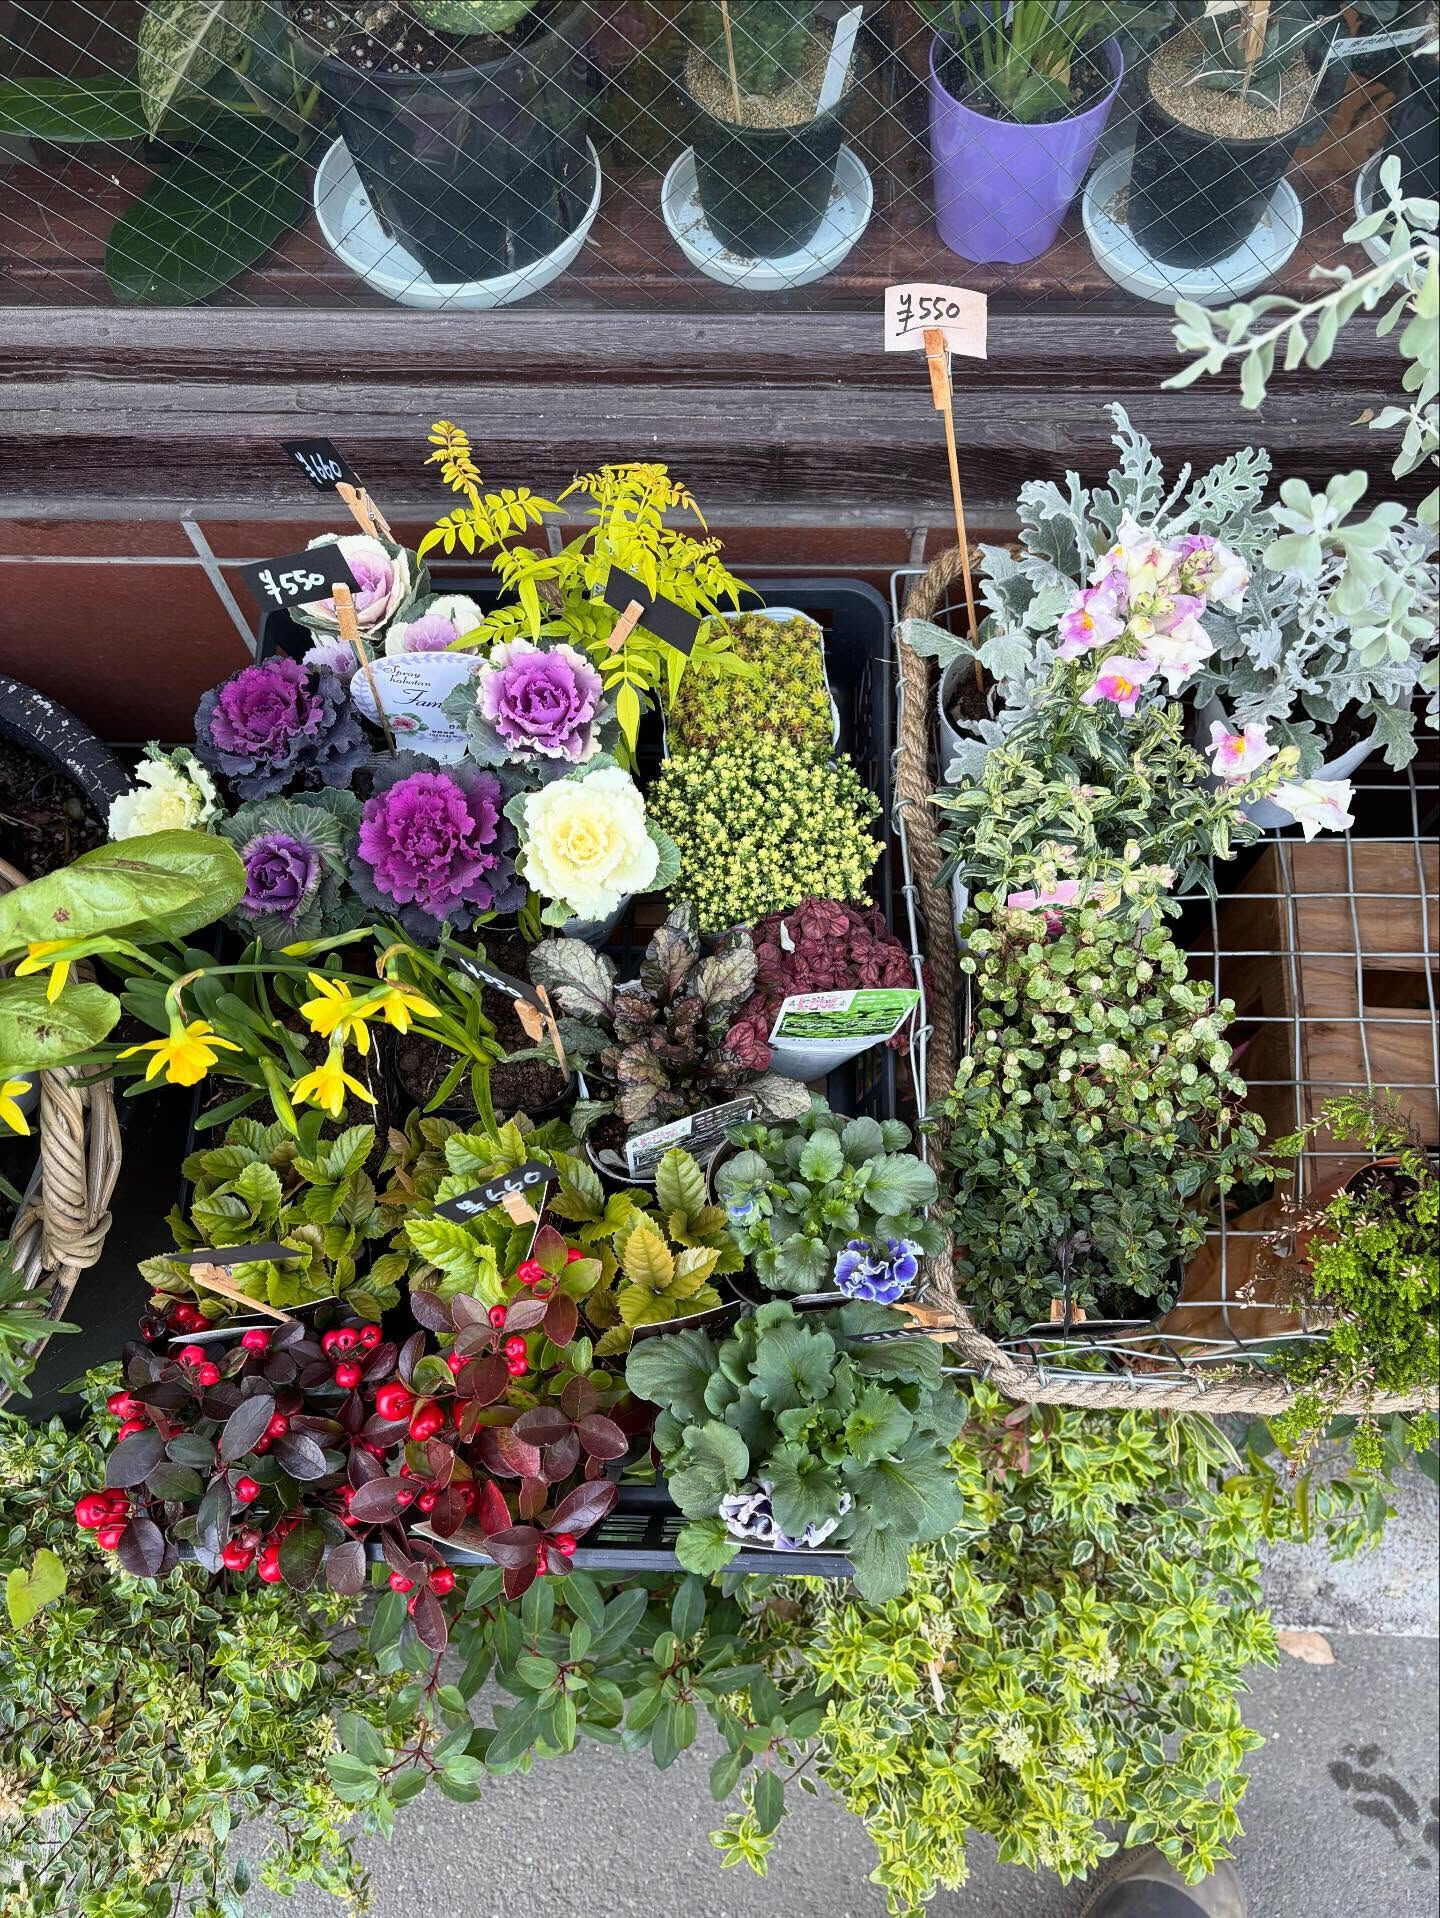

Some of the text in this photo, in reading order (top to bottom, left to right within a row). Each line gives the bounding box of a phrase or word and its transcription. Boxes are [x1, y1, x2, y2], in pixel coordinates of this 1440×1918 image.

[896, 293, 961, 332] ¥550
[294, 451, 343, 484] ¥660
[258, 569, 325, 605] ¥550
[383, 665, 421, 679] Spray
[459, 957, 524, 998] ¥550
[455, 1171, 541, 1214] ¥660
